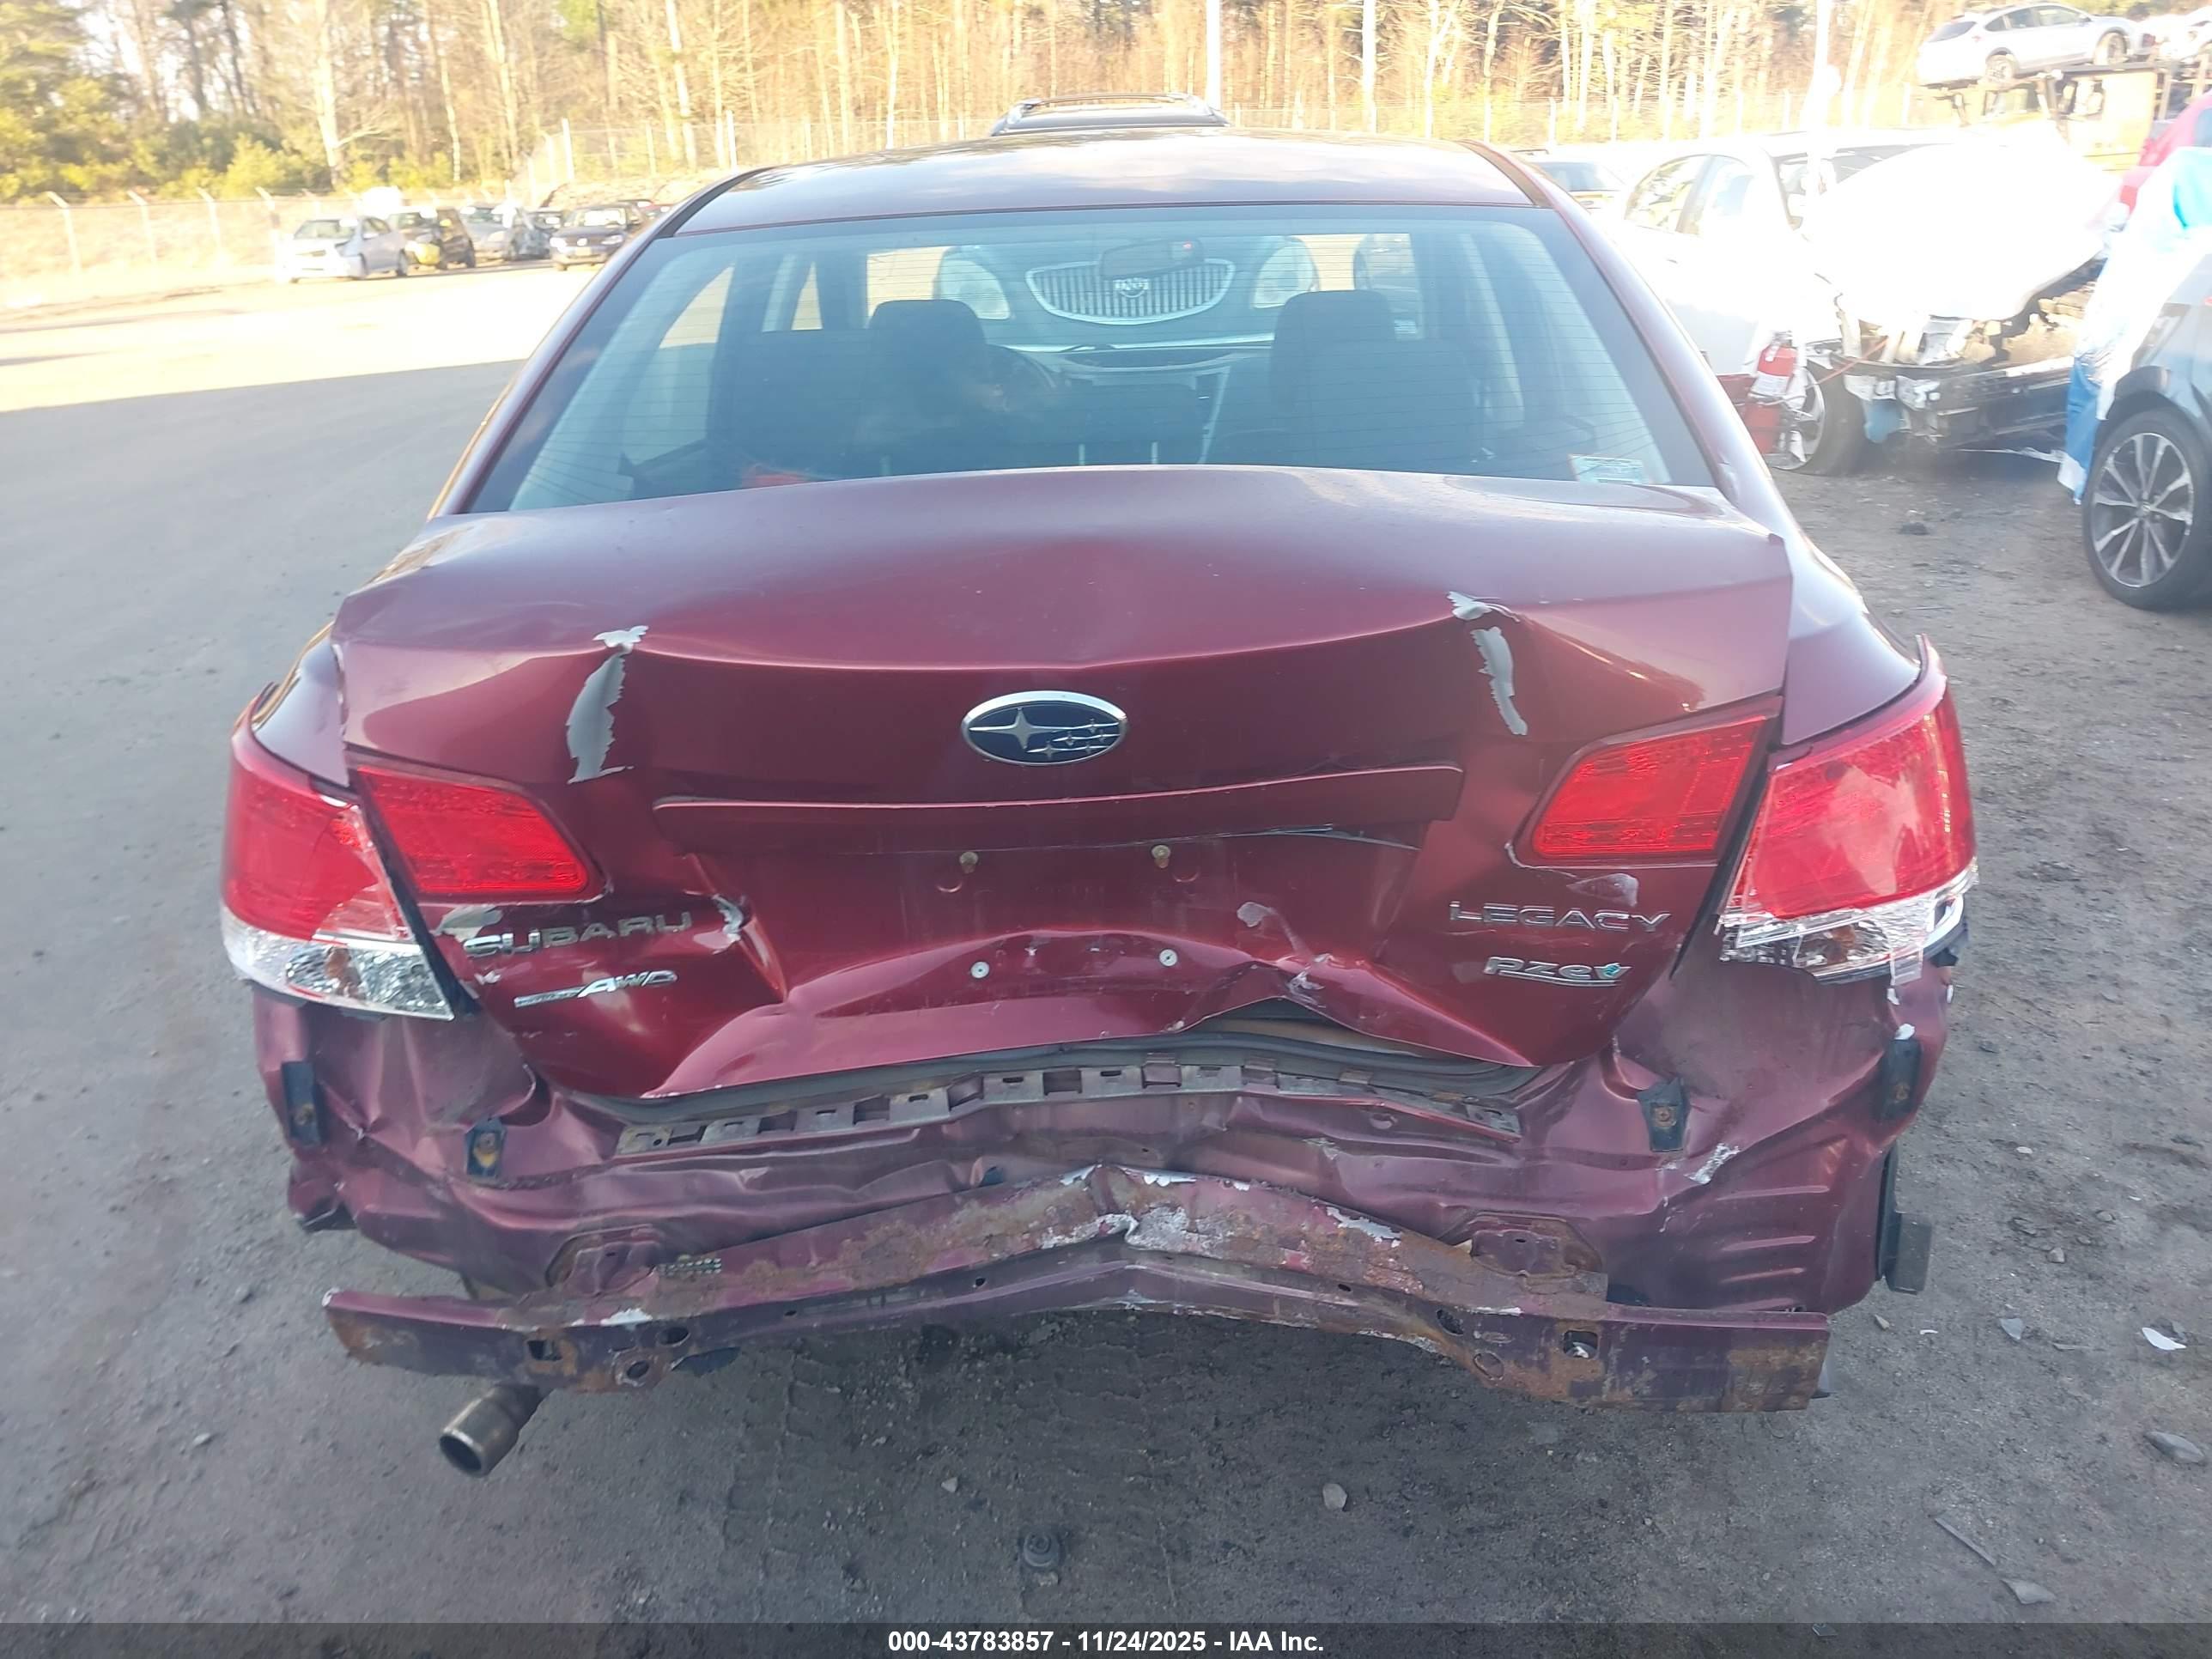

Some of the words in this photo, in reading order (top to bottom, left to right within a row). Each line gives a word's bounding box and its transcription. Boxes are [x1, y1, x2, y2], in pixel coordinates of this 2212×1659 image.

[1449, 901, 1670, 932] LEGACY
[465, 912, 691, 957] SUBARU
[578, 970, 678, 998] AWD
